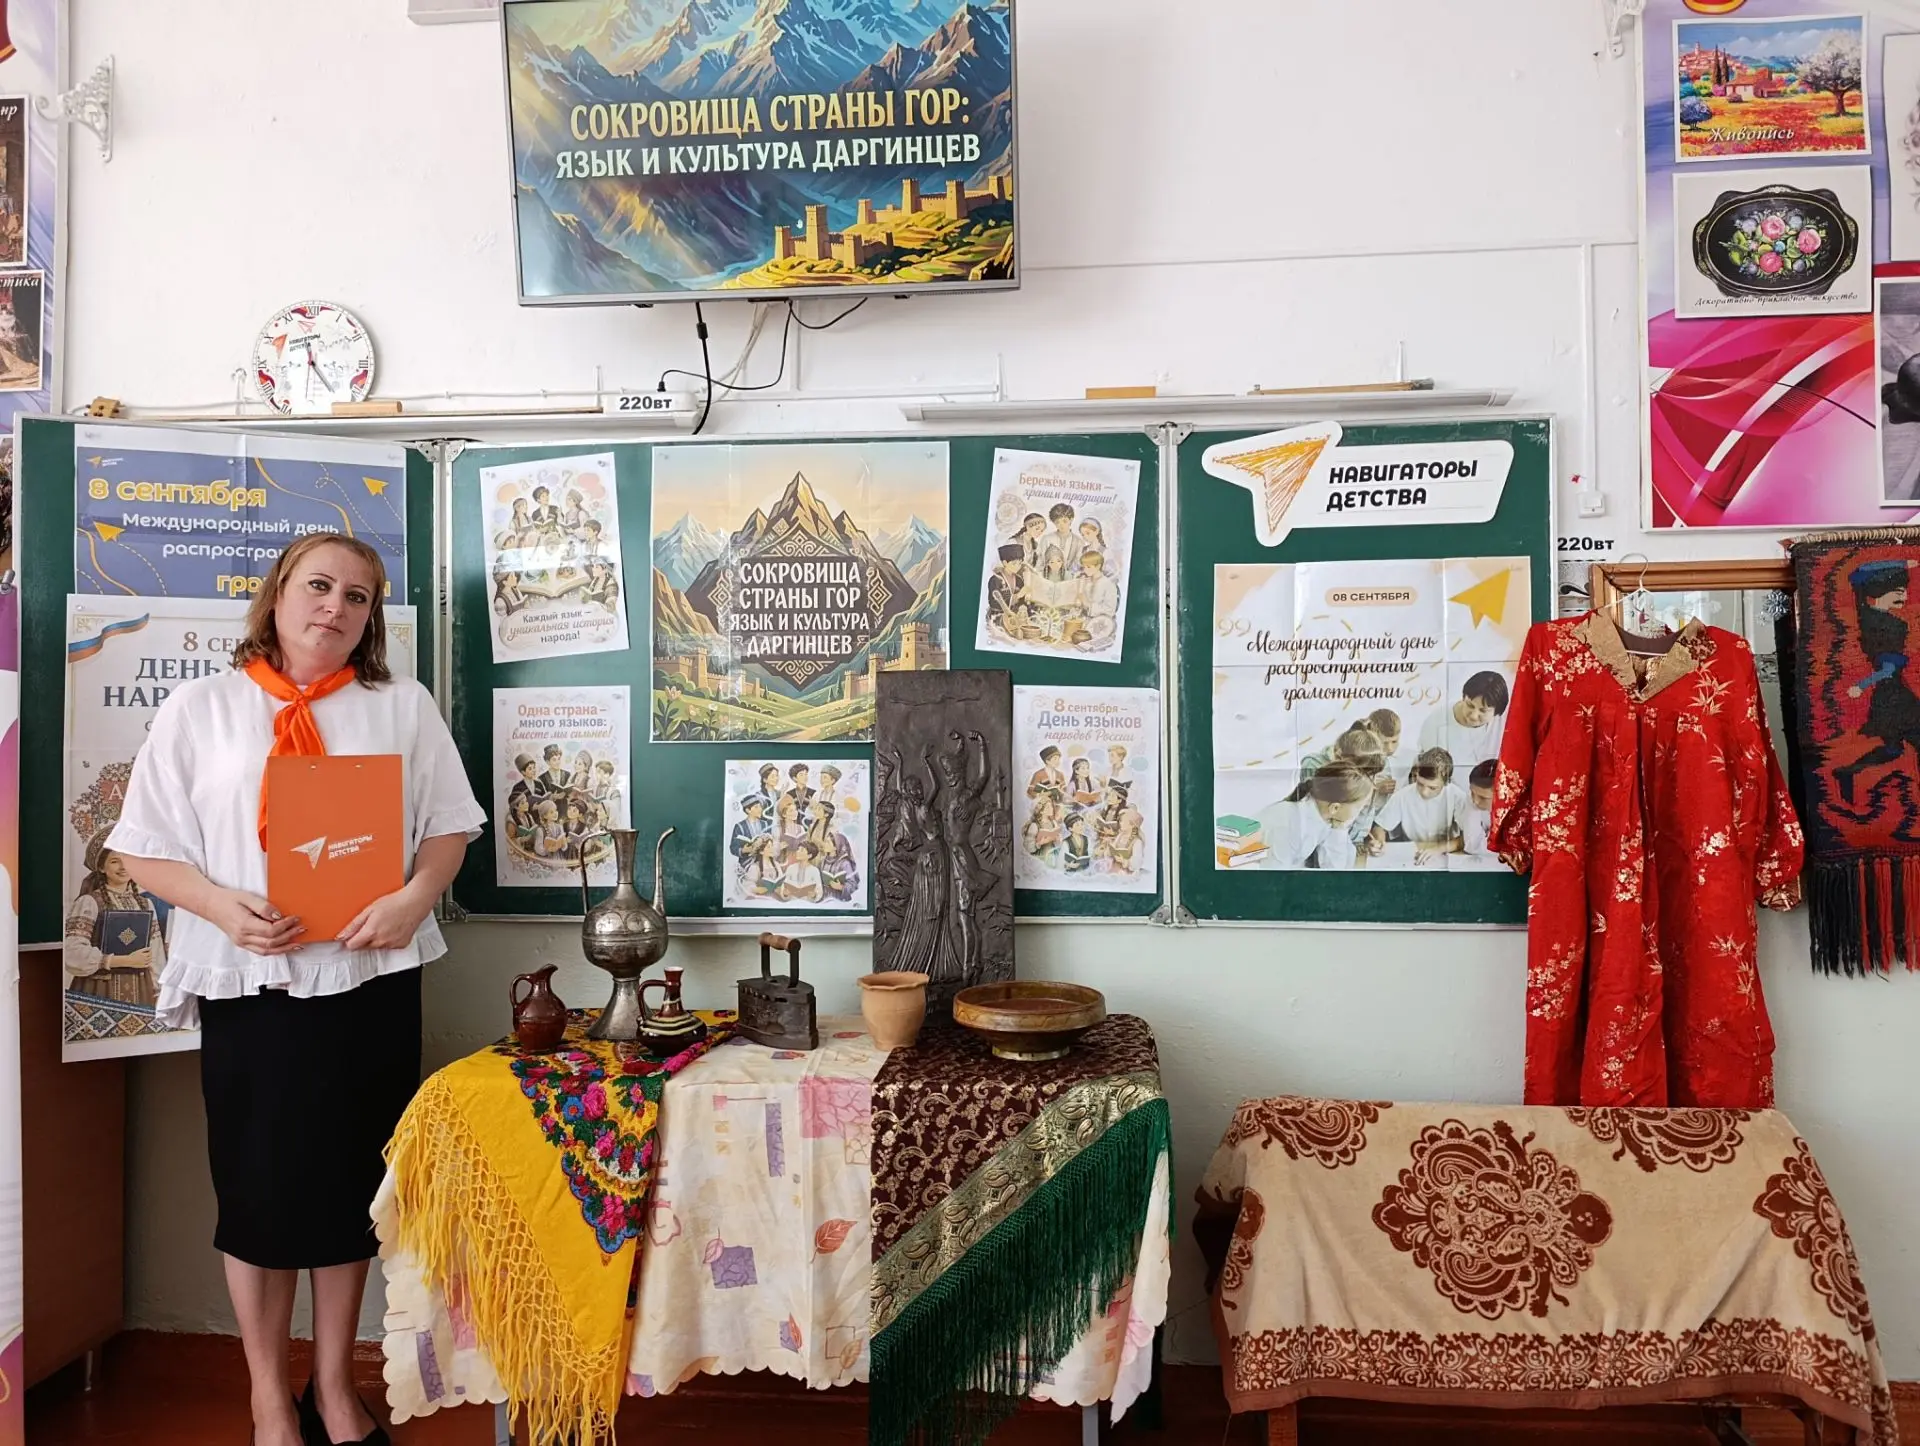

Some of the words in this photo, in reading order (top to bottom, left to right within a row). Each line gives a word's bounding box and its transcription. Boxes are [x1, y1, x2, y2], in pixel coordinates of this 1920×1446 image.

[570, 97, 763, 140] СОКРОВИЩА
[770, 90, 895, 132] СТРАНЫ
[904, 87, 970, 126] ГОР:
[1707, 126, 1796, 144] Живопись
[556, 148, 634, 179] ЯЗЫК
[642, 147, 660, 175] И
[668, 141, 806, 174] КУЛЬТУРА
[812, 134, 981, 173] ДАРГИНЦЕВ
[1329, 459, 1479, 485] НАВИГАТОРЫ
[88, 478, 109, 500] 8
[116, 479, 267, 512] сентября
[1069, 480, 1102, 491] языки
[1325, 487, 1428, 512] ДЕТСТВА
[122, 513, 290, 535] Международный
[294, 521, 339, 535] день
[740, 562, 861, 587] СОКРОВИЩА
[739, 587, 818, 609] СТРАНЫ
[826, 587, 861, 609] ГОР
[1333, 592, 1347, 602] 08
[1350, 592, 1410, 601] СЕНТЯБРЯ
[523, 612, 558, 623] Каждый
[560, 610, 583, 619] язык
[730, 613, 774, 631] ЯЗЫК
[778, 613, 789, 631] И
[793, 612, 870, 631] КУЛЬТУРА
[507, 622, 570, 641] уникальная
[572, 617, 614, 631] история
[540, 630, 581, 643] народа!
[183, 631, 199, 652] 8
[746, 635, 852, 658] ДАРГИНЦЕВ
[1247, 630, 1396, 661] Международный
[1400, 638, 1438, 659] день
[136, 658, 221, 681] ДЕНЬ
[1264, 663, 1418, 685] распространения
[1054, 698, 1065, 712] 8
[1067, 703, 1119, 715] сентября
[1282, 686, 1405, 711] грамотности
[518, 704, 550, 717] Одна
[554, 705, 598, 717] страна
[1037, 711, 1080, 729] День
[1084, 716, 1142, 729] языков
[512, 728, 549, 740] вместе
[519, 719, 555, 728] много
[559, 718, 607, 728] языков:
[1044, 728, 1093, 744] народов
[1095, 728, 1135, 742] России
